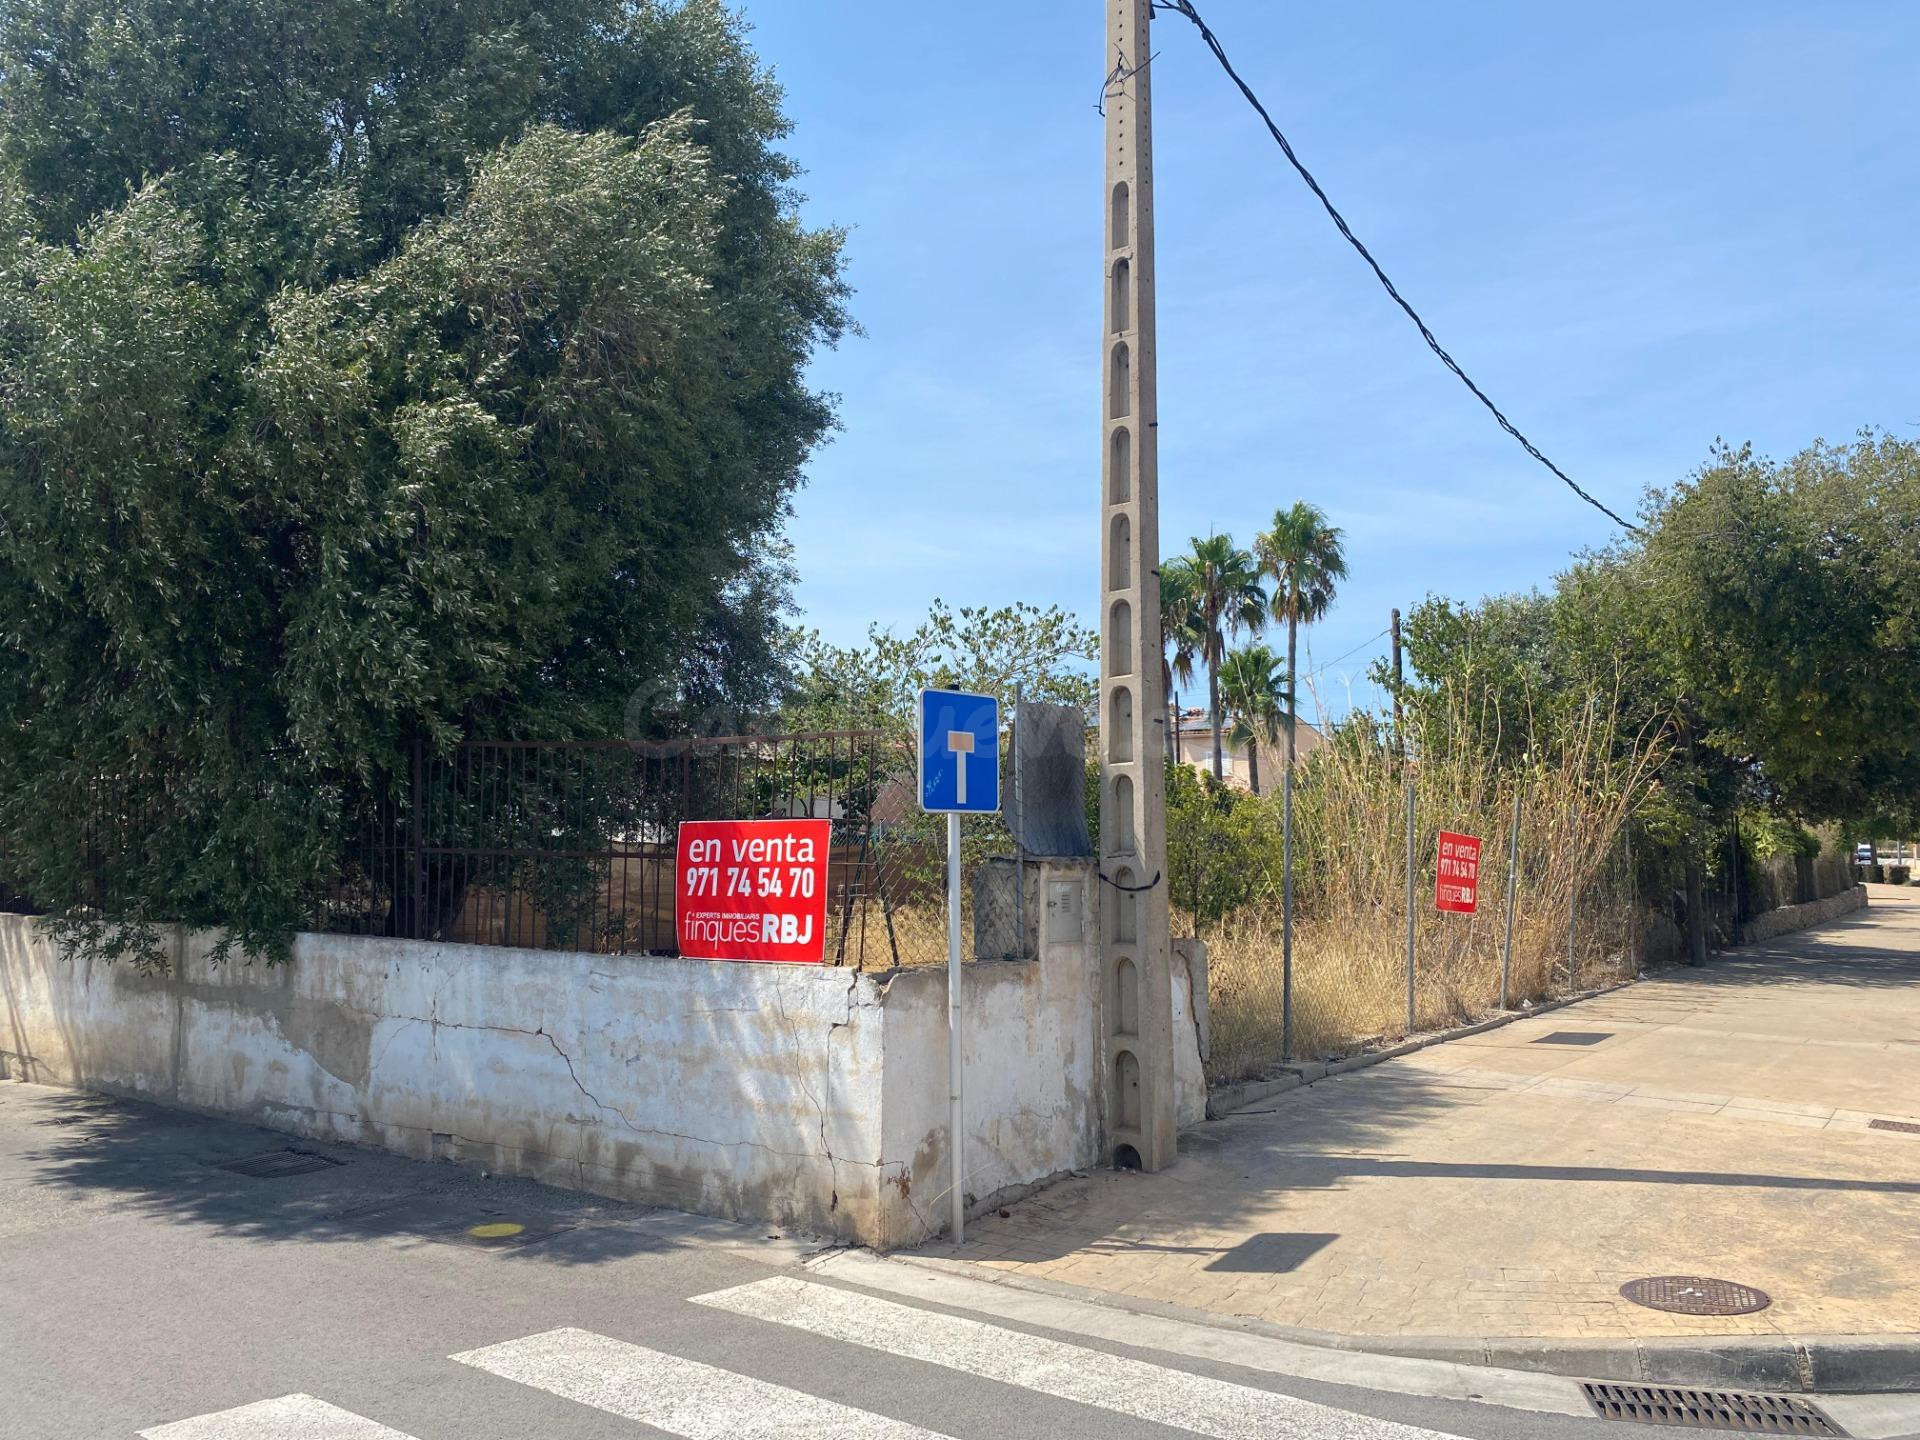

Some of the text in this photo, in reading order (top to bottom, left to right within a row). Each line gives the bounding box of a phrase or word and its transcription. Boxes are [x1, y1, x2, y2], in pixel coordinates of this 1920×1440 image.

[689, 833, 815, 863] en venta
[1442, 841, 1477, 860] en venta
[1440, 858, 1451, 876] 971
[1452, 860, 1459, 877] 74
[1460, 862, 1467, 878] 54
[687, 867, 815, 898] 971 74 54 70
